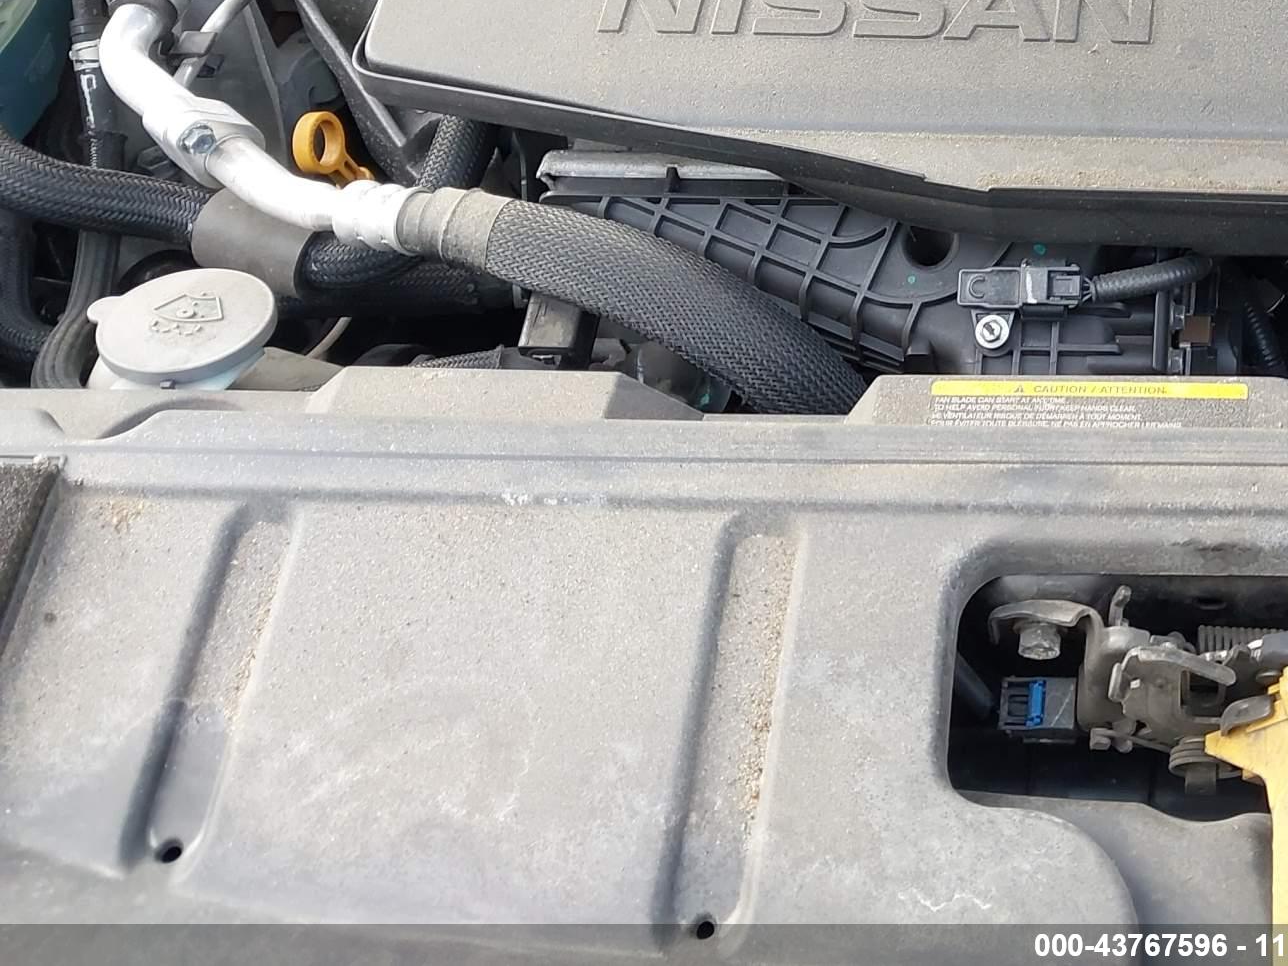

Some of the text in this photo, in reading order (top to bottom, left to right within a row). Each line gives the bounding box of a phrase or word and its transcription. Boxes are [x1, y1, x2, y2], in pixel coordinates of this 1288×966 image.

[1033, 384, 1087, 394] CAUTION
[1099, 385, 1167, 395] ATTENTION
[977, 395, 995, 403] CAN
[966, 403, 990, 411] AVOID
